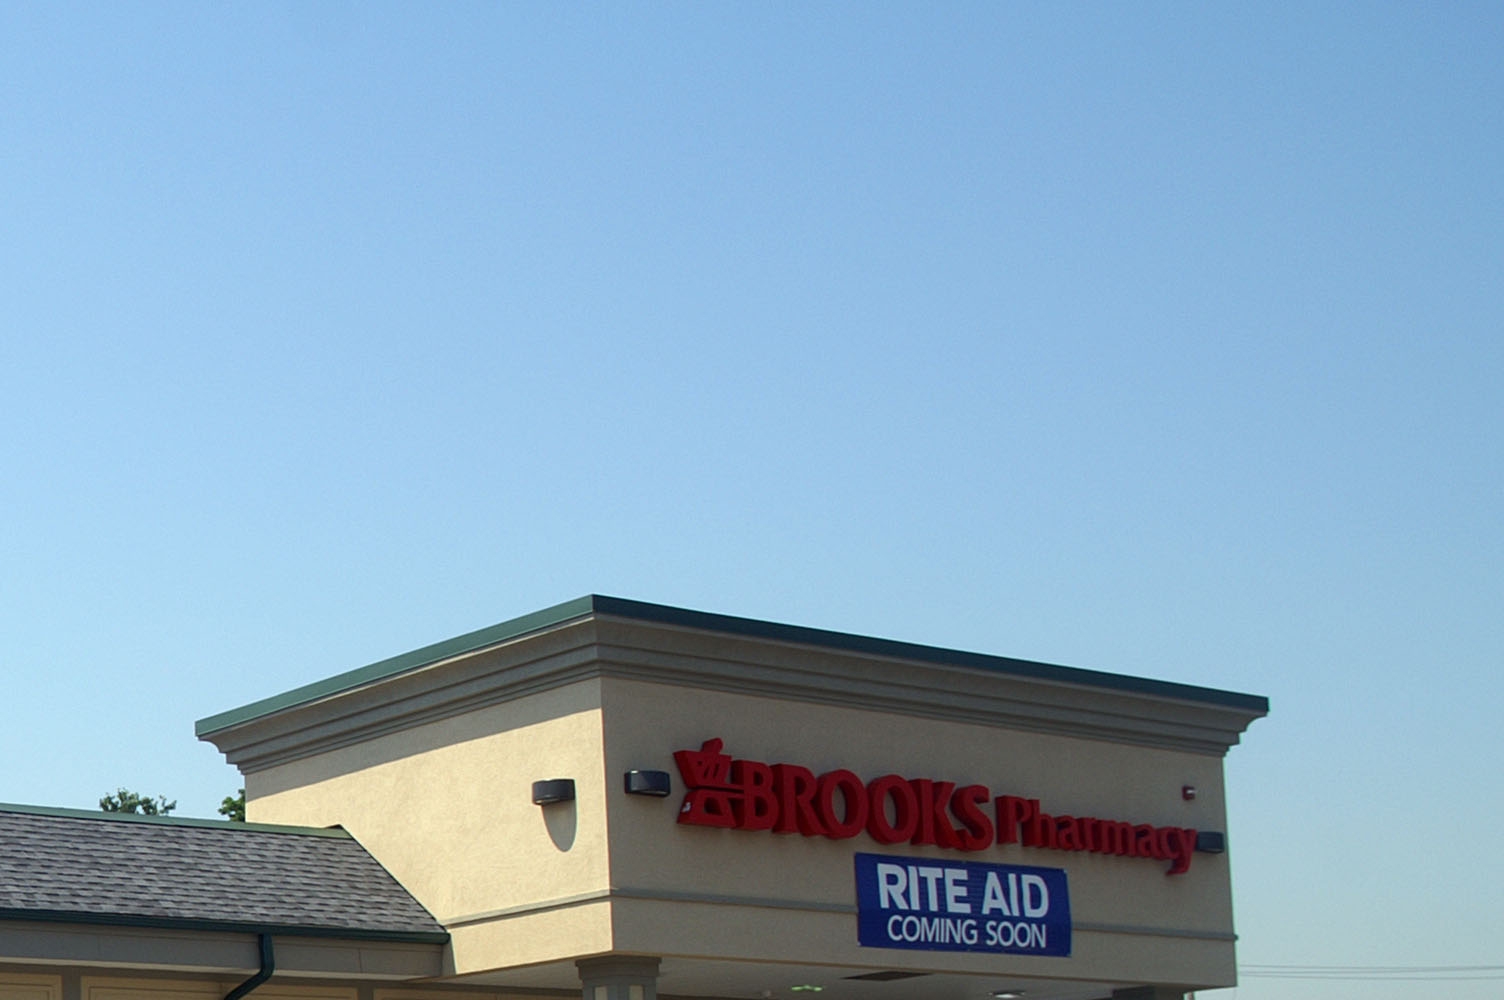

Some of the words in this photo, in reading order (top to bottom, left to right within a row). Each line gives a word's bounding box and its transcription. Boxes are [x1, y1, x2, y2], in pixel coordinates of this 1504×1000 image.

[732, 759, 994, 851] BROOKS
[995, 795, 1197, 876] Pharmacy
[877, 863, 972, 915] RITE
[982, 871, 1049, 918] AID
[887, 915, 978, 945] COMING
[986, 921, 1046, 949] SOON
